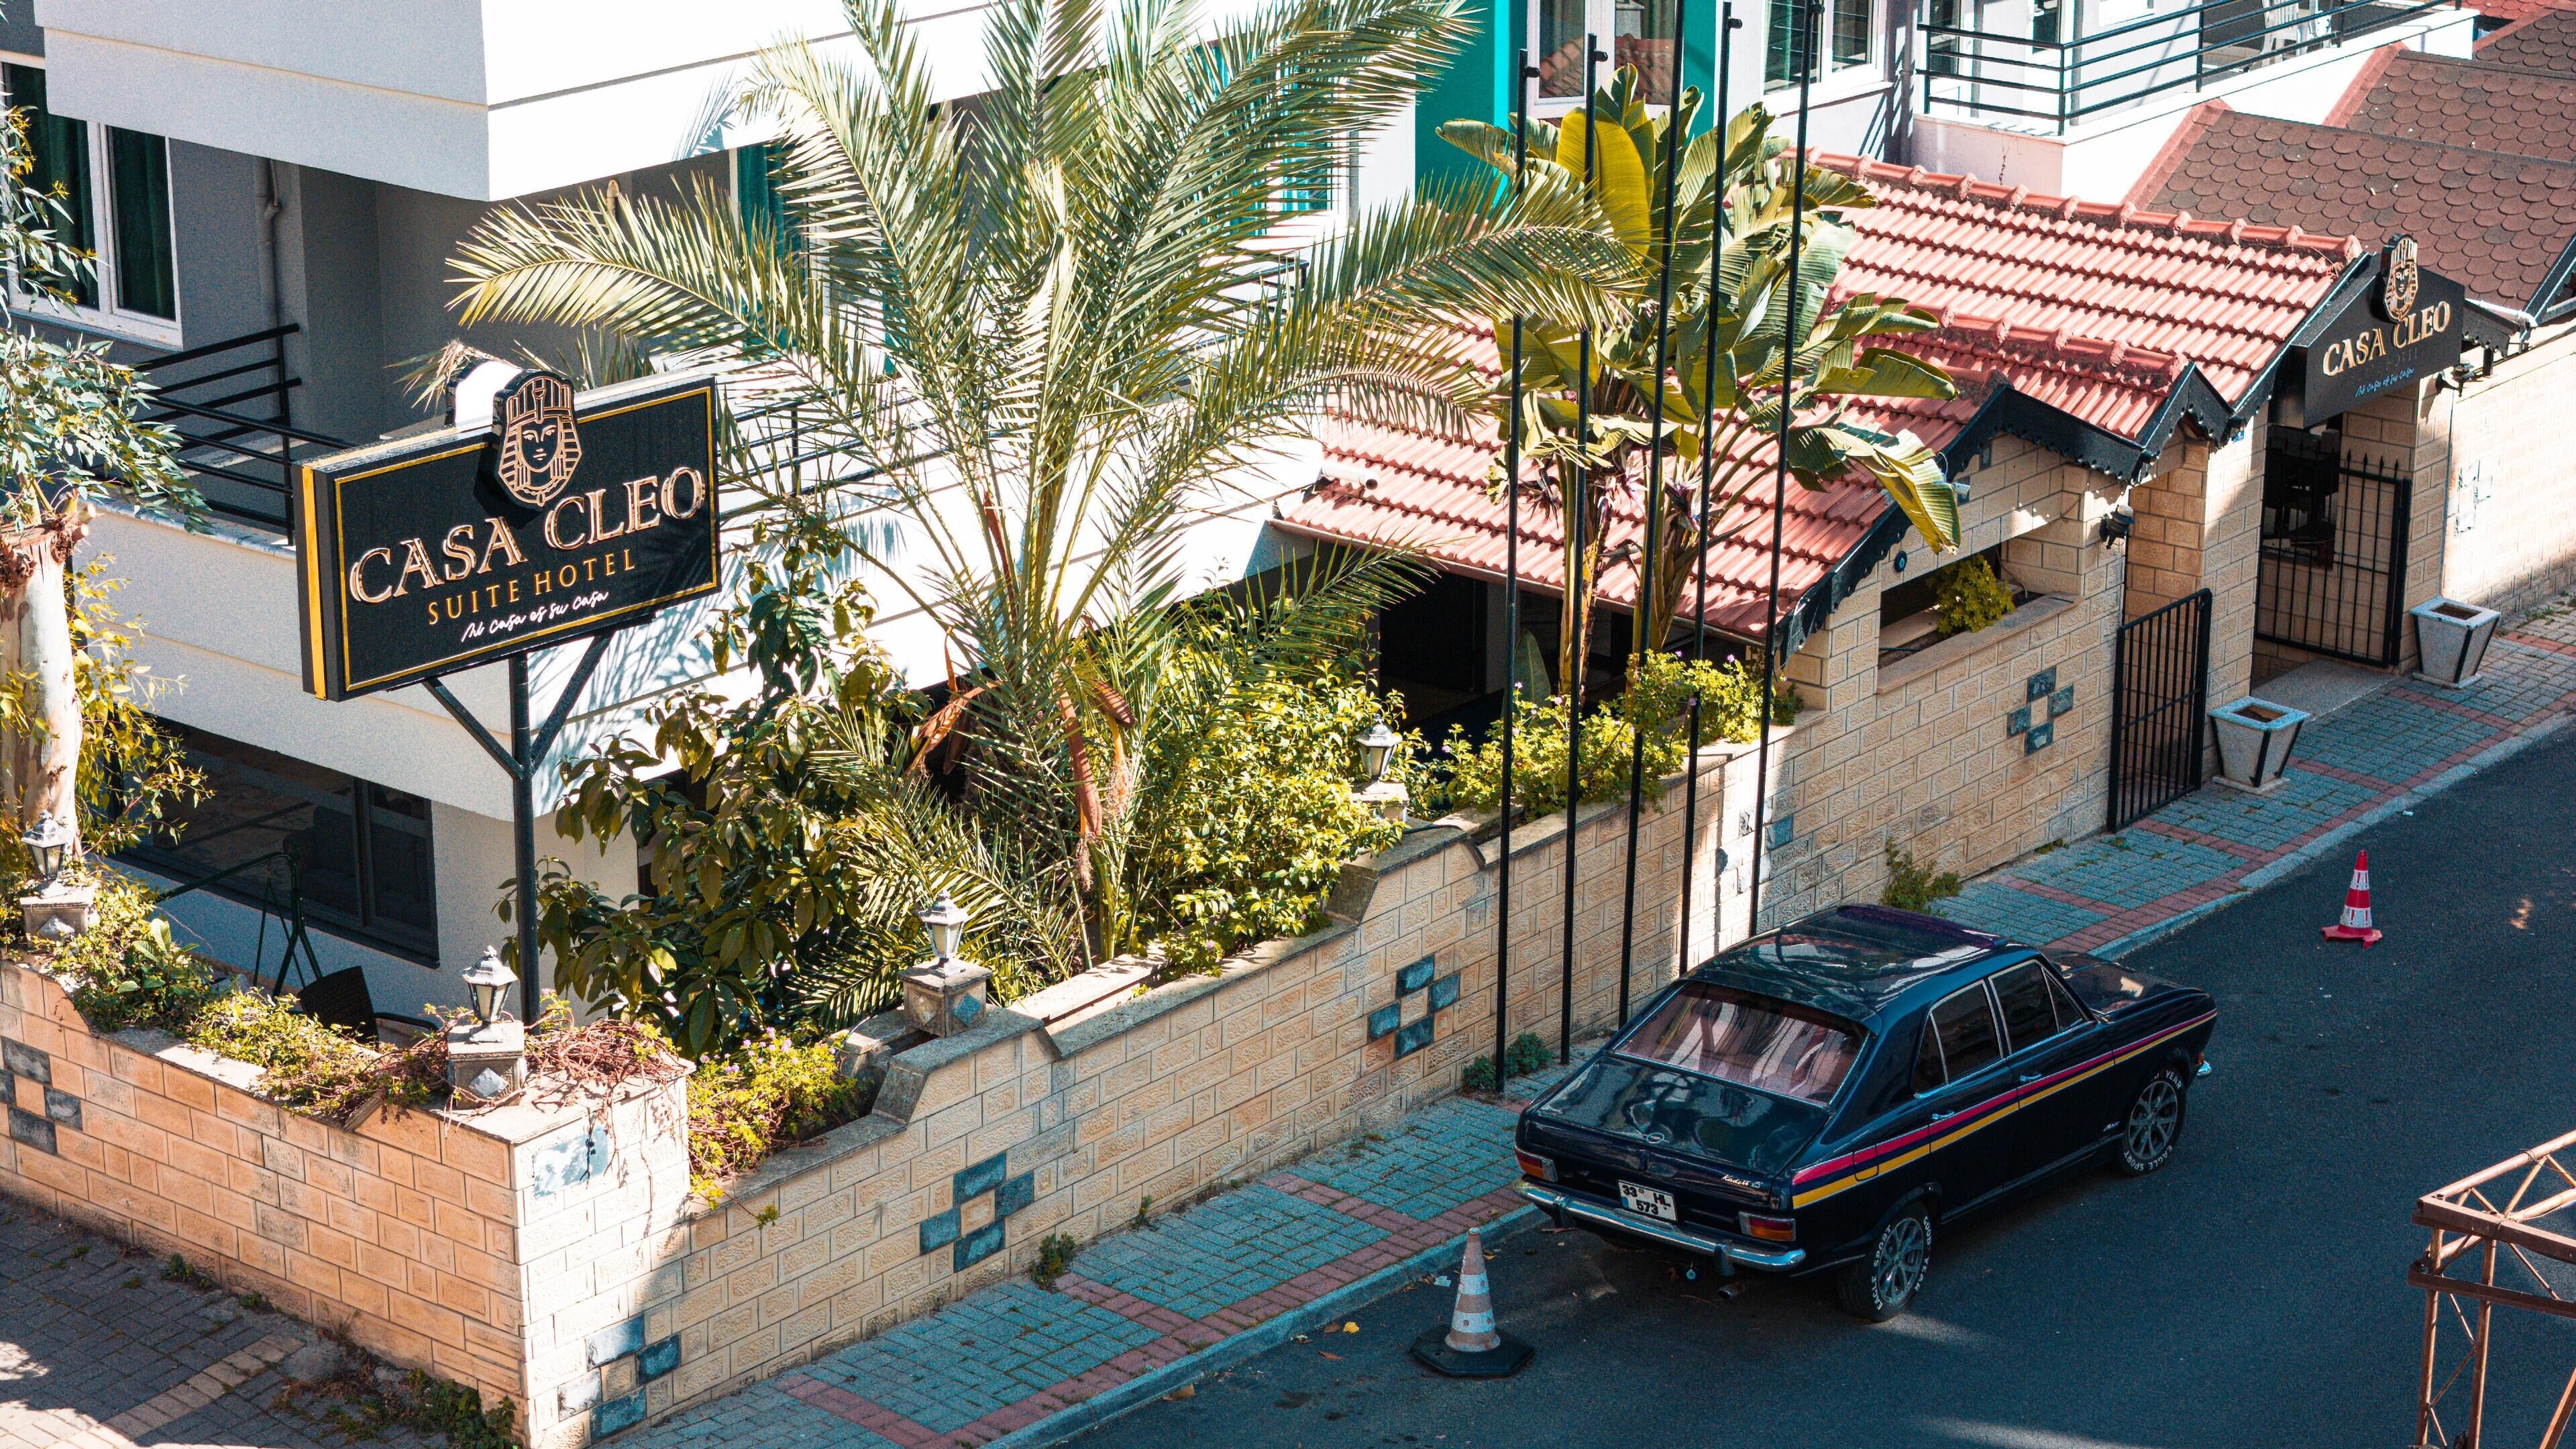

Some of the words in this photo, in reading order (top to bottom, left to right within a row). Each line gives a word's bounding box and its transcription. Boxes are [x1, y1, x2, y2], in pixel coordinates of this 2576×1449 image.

[2323, 328, 2386, 376] CASA
[2393, 301, 2451, 349] CLEO
[349, 516, 529, 603] CASA
[544, 466, 706, 550] CLEO
[428, 579, 520, 625] SUITE
[534, 549, 635, 595] HOTEL
[2165, 1070, 2184, 1089] YEAR
[2123, 1150, 2145, 1171] SPORT
[2148, 1144, 2173, 1171] EAGLE
[1721, 1174, 1750, 1186] Kadett
[1622, 1184, 1638, 1198] 33
[1652, 1192, 1671, 1208] HL
[1635, 1199, 1659, 1216] 573
[1873, 1224, 1891, 1267] SPORT
[1923, 1216, 1931, 1246] GOOD
[1914, 1256, 1930, 1291] YEAR
[1871, 1274, 1884, 1310] EAGLE
